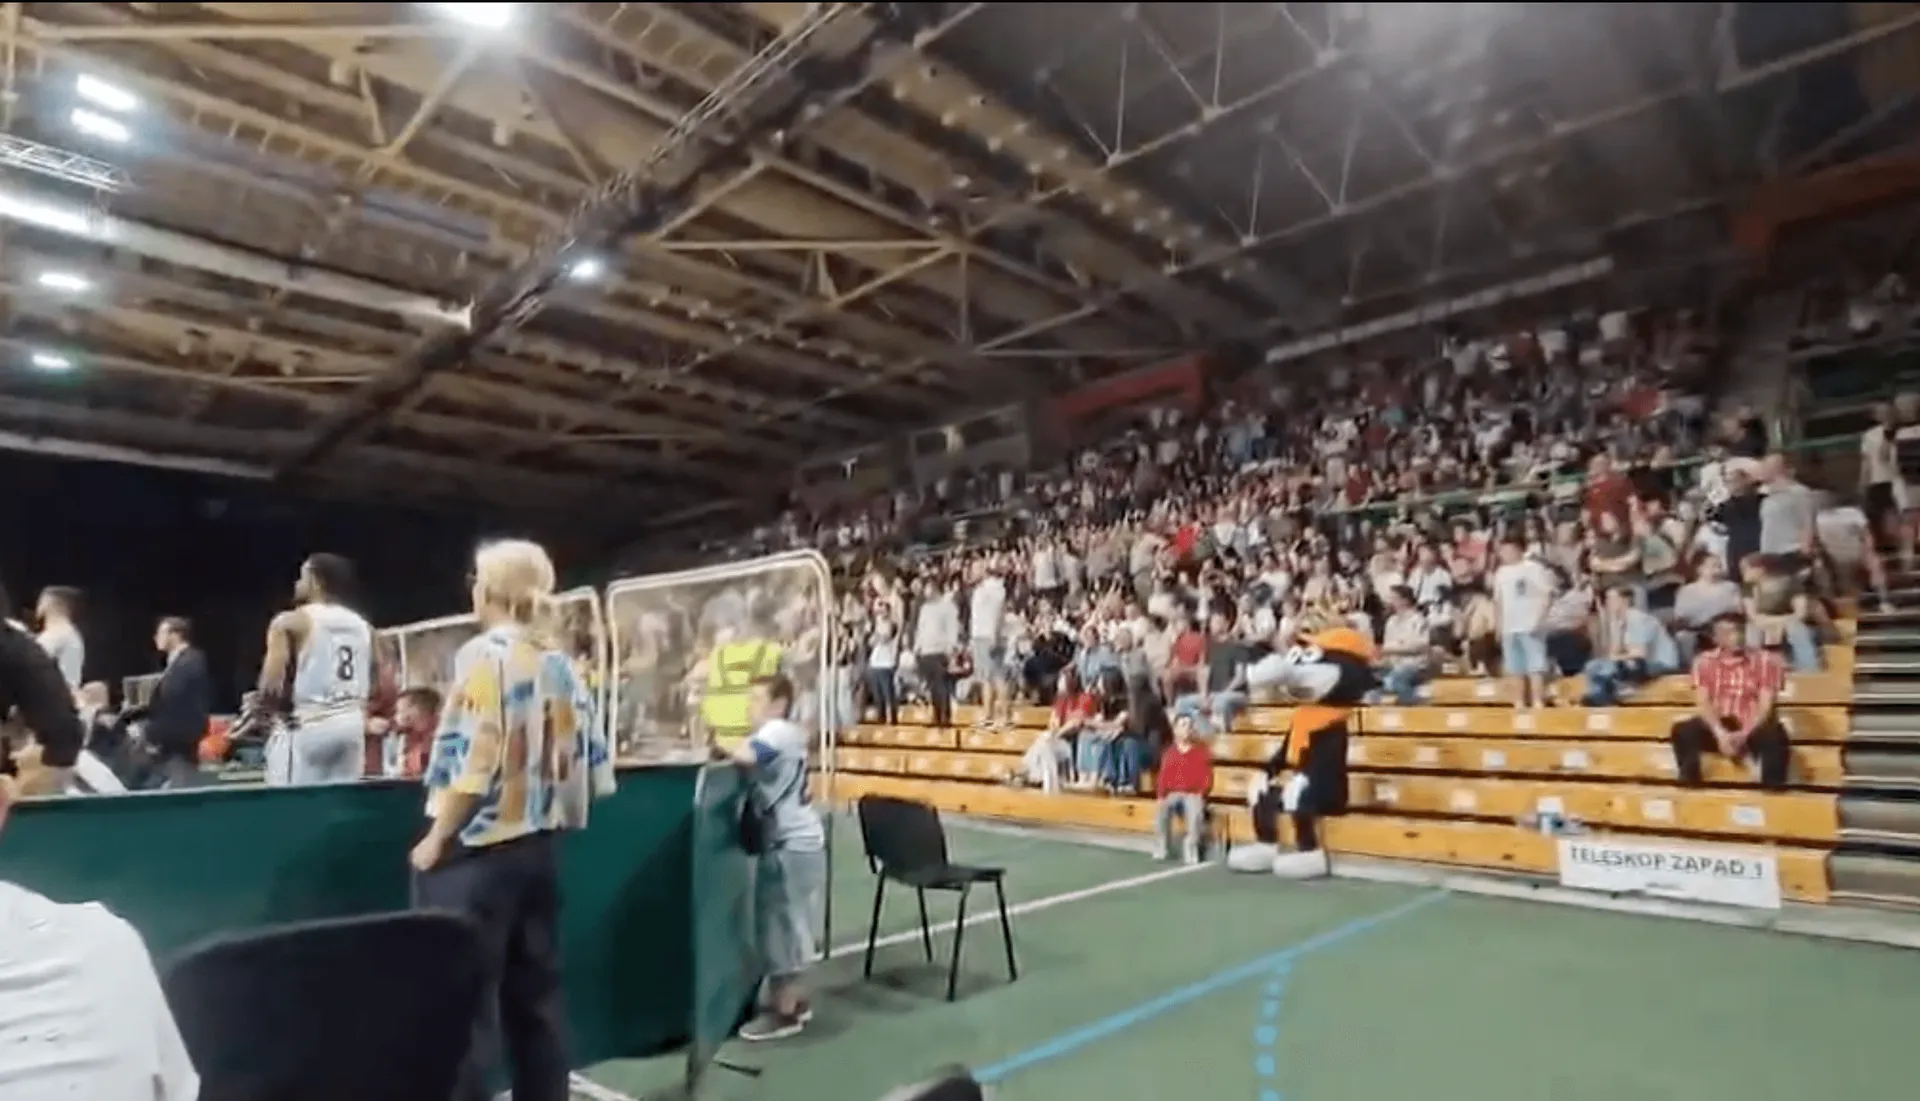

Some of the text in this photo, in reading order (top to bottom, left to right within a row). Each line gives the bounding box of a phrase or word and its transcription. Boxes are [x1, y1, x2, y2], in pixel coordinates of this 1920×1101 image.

[337, 645, 354, 680] 8
[1571, 846, 1667, 870] TELESKOP
[1672, 855, 1745, 877] ZAPAD
